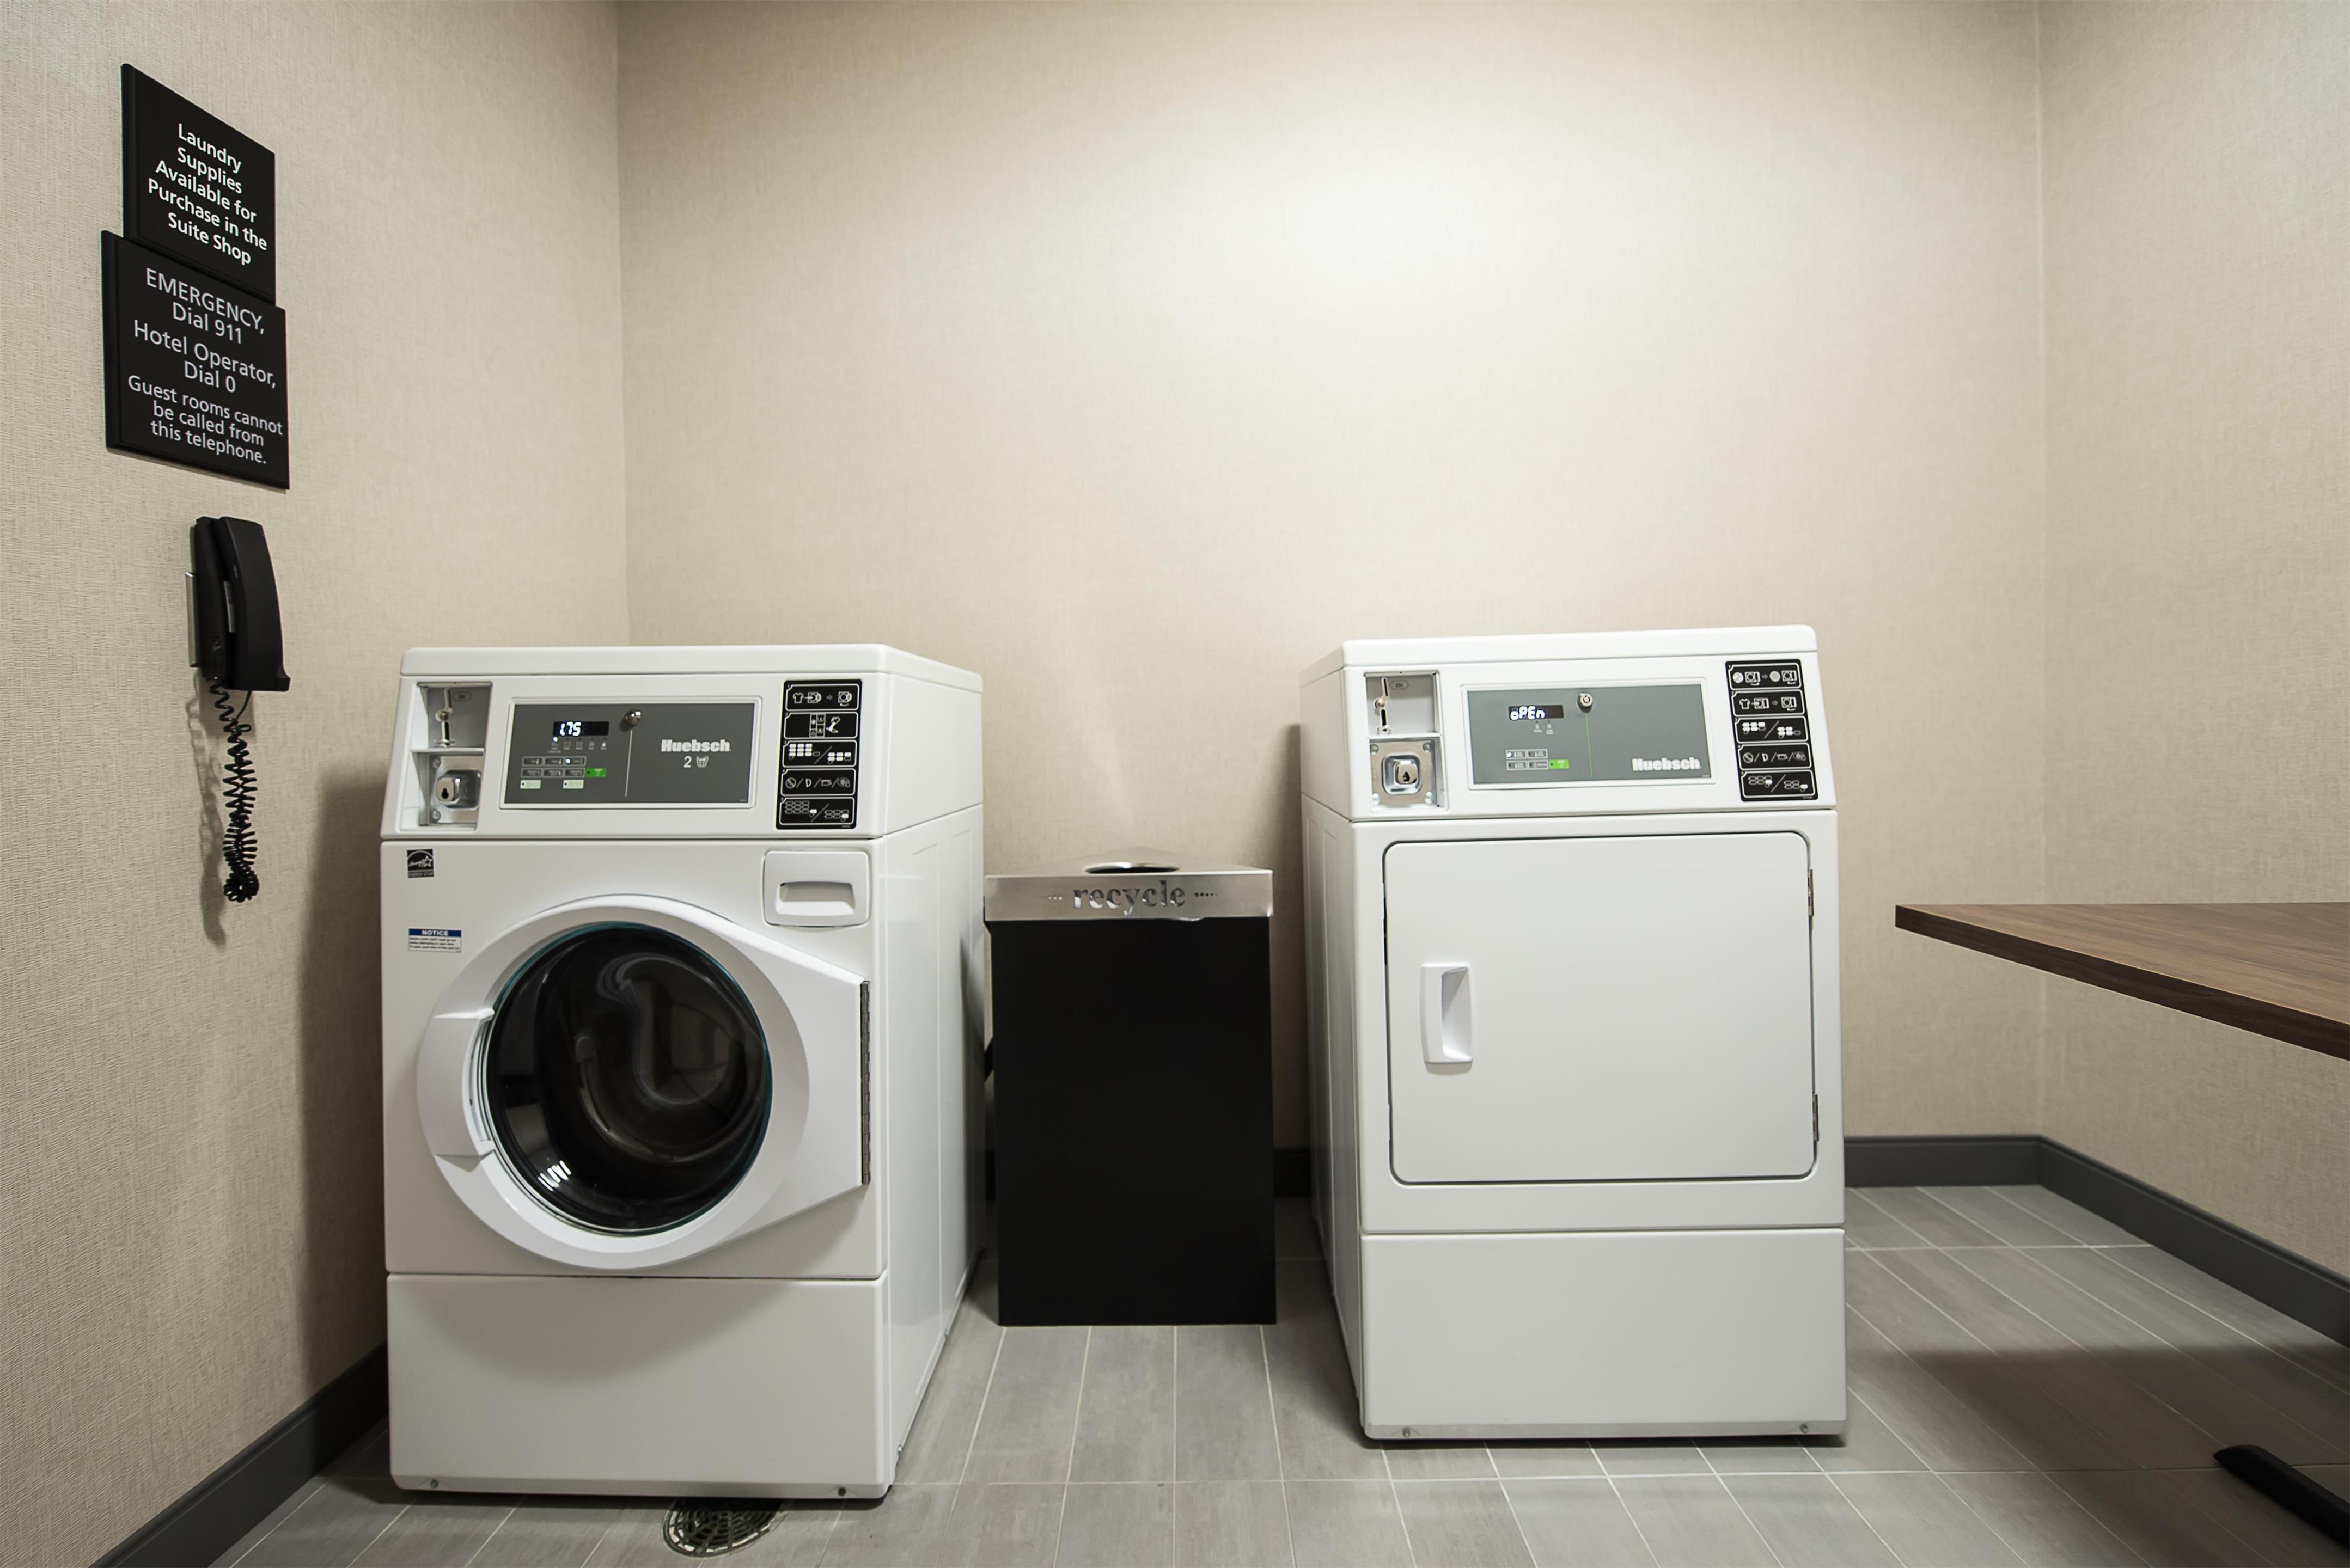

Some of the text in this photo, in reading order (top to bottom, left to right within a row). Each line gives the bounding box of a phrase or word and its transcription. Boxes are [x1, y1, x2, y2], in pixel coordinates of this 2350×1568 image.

[178, 123, 242, 174] Laundry
[178, 146, 242, 194] Supplies
[148, 177, 268, 250] Purchase in the
[155, 160, 257, 223] Available for
[168, 212, 251, 265] Suite Shop
[147, 267, 264, 335] EMERGENCY,
[173, 302, 241, 344] Dial 911
[134, 319, 276, 389] Hotel Operator,
[184, 360, 236, 393] Dial 0
[128, 375, 283, 436] Guest rooms cannot
[154, 400, 264, 446] be called from
[150, 420, 267, 464] this telephone.
[661, 739, 730, 753] Huebsch
[683, 756, 692, 768] 2
[1632, 757, 1701, 772] Huebsch
[1073, 879, 1185, 916] recycle
